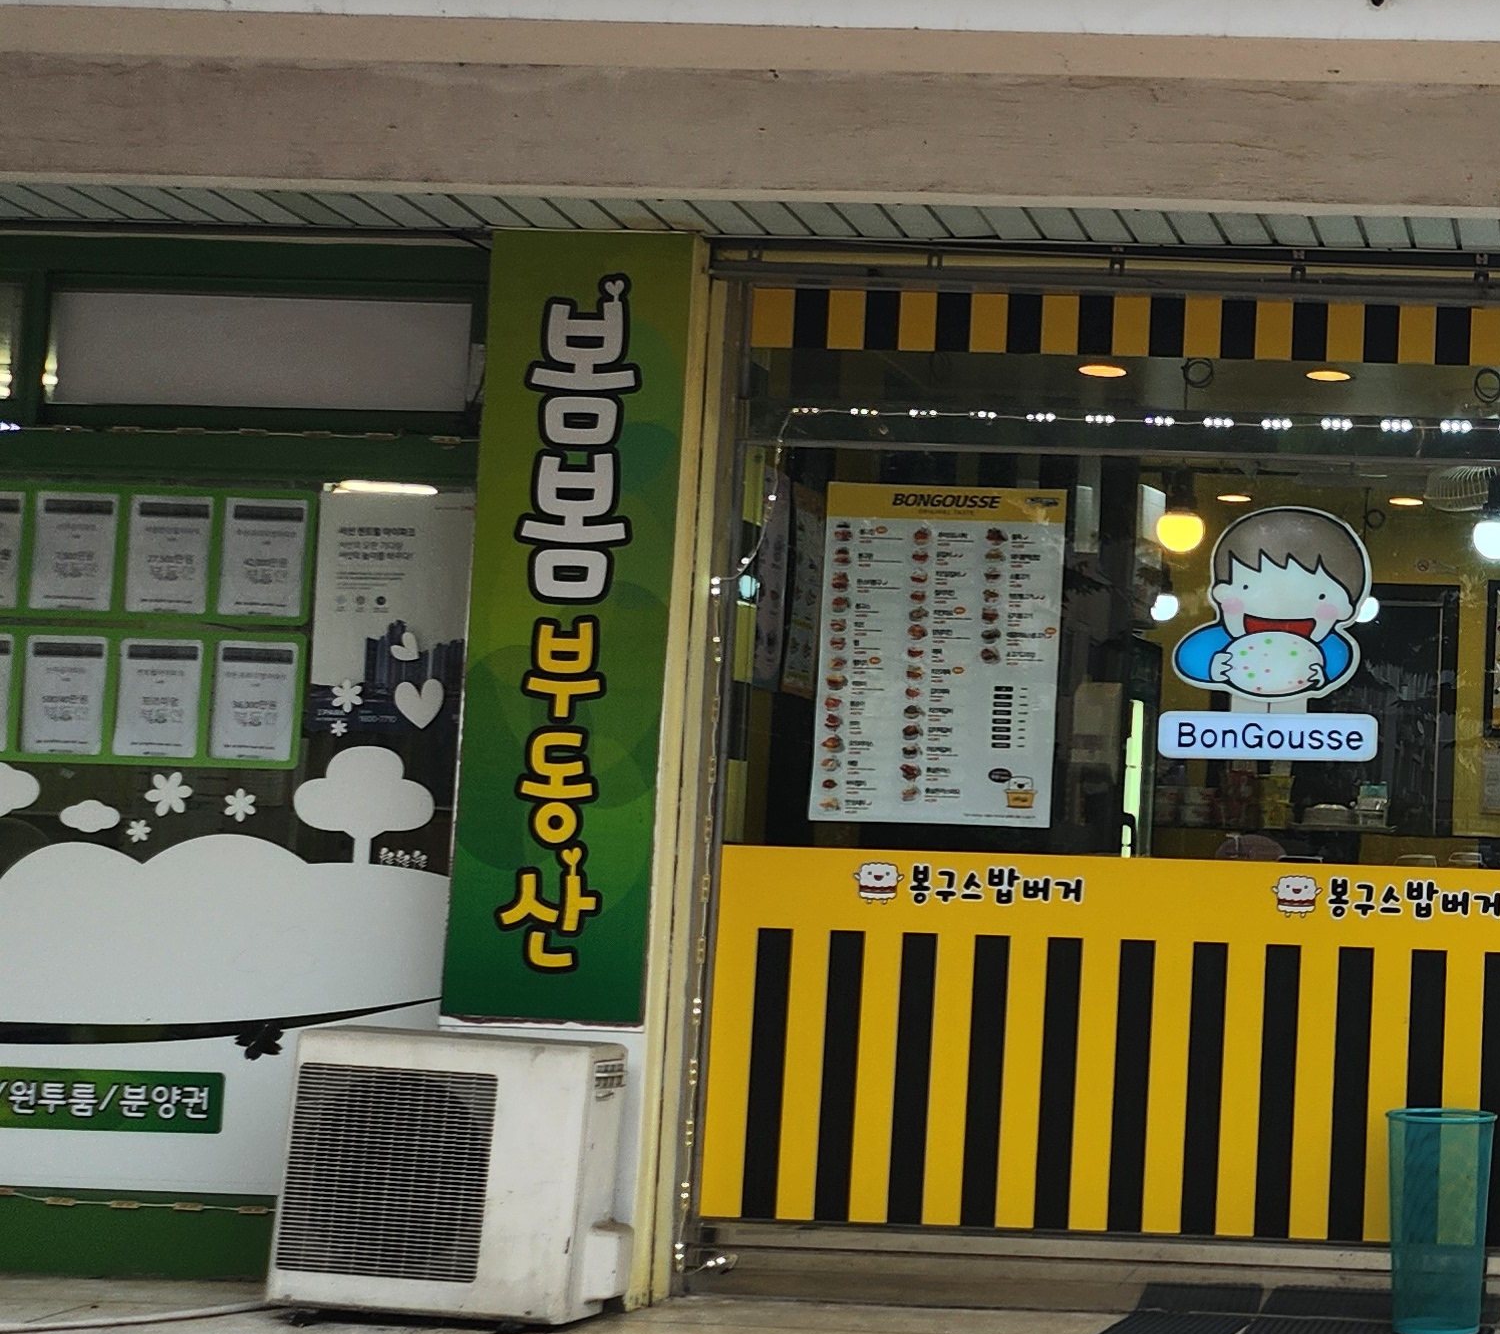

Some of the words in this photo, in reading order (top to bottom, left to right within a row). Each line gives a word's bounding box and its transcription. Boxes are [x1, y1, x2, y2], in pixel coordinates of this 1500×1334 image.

[892, 492, 1002, 509] BONGOUSSE
[1176, 721, 1364, 751] BonGousse
[500, 622, 602, 969] 부동산
[908, 863, 1085, 904] 봉구스밥버거
